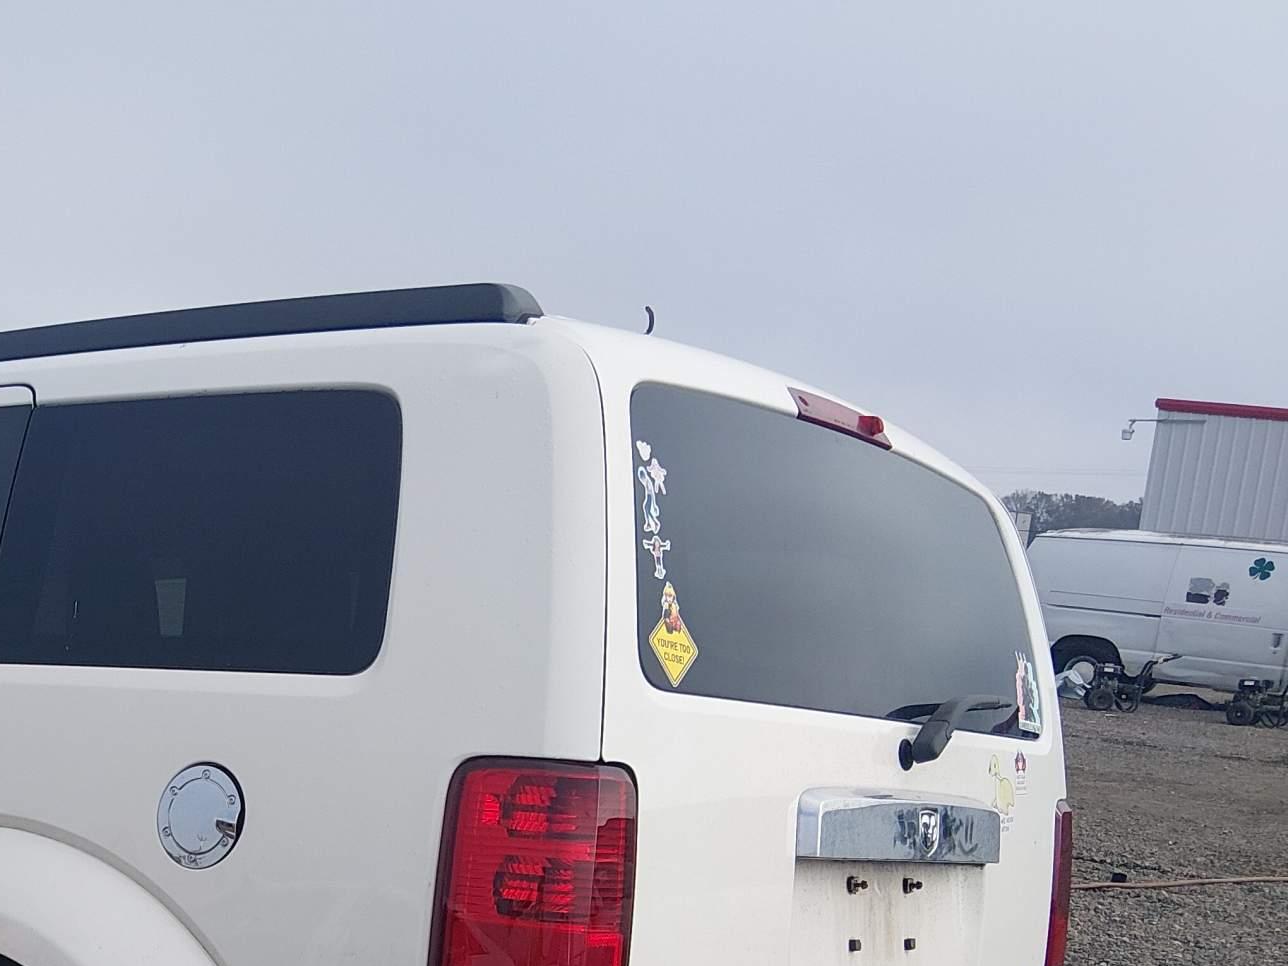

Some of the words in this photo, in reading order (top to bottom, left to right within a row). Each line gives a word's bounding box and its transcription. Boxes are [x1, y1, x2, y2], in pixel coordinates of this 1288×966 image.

[1164, 606, 1205, 618] Residential
[1206, 611, 1213, 619] &
[1214, 612, 1261, 624] Commercial
[656, 638, 679, 652] YOU'RE
[679, 643, 691, 655] TOO
[664, 652, 685, 665] CLOSE!
